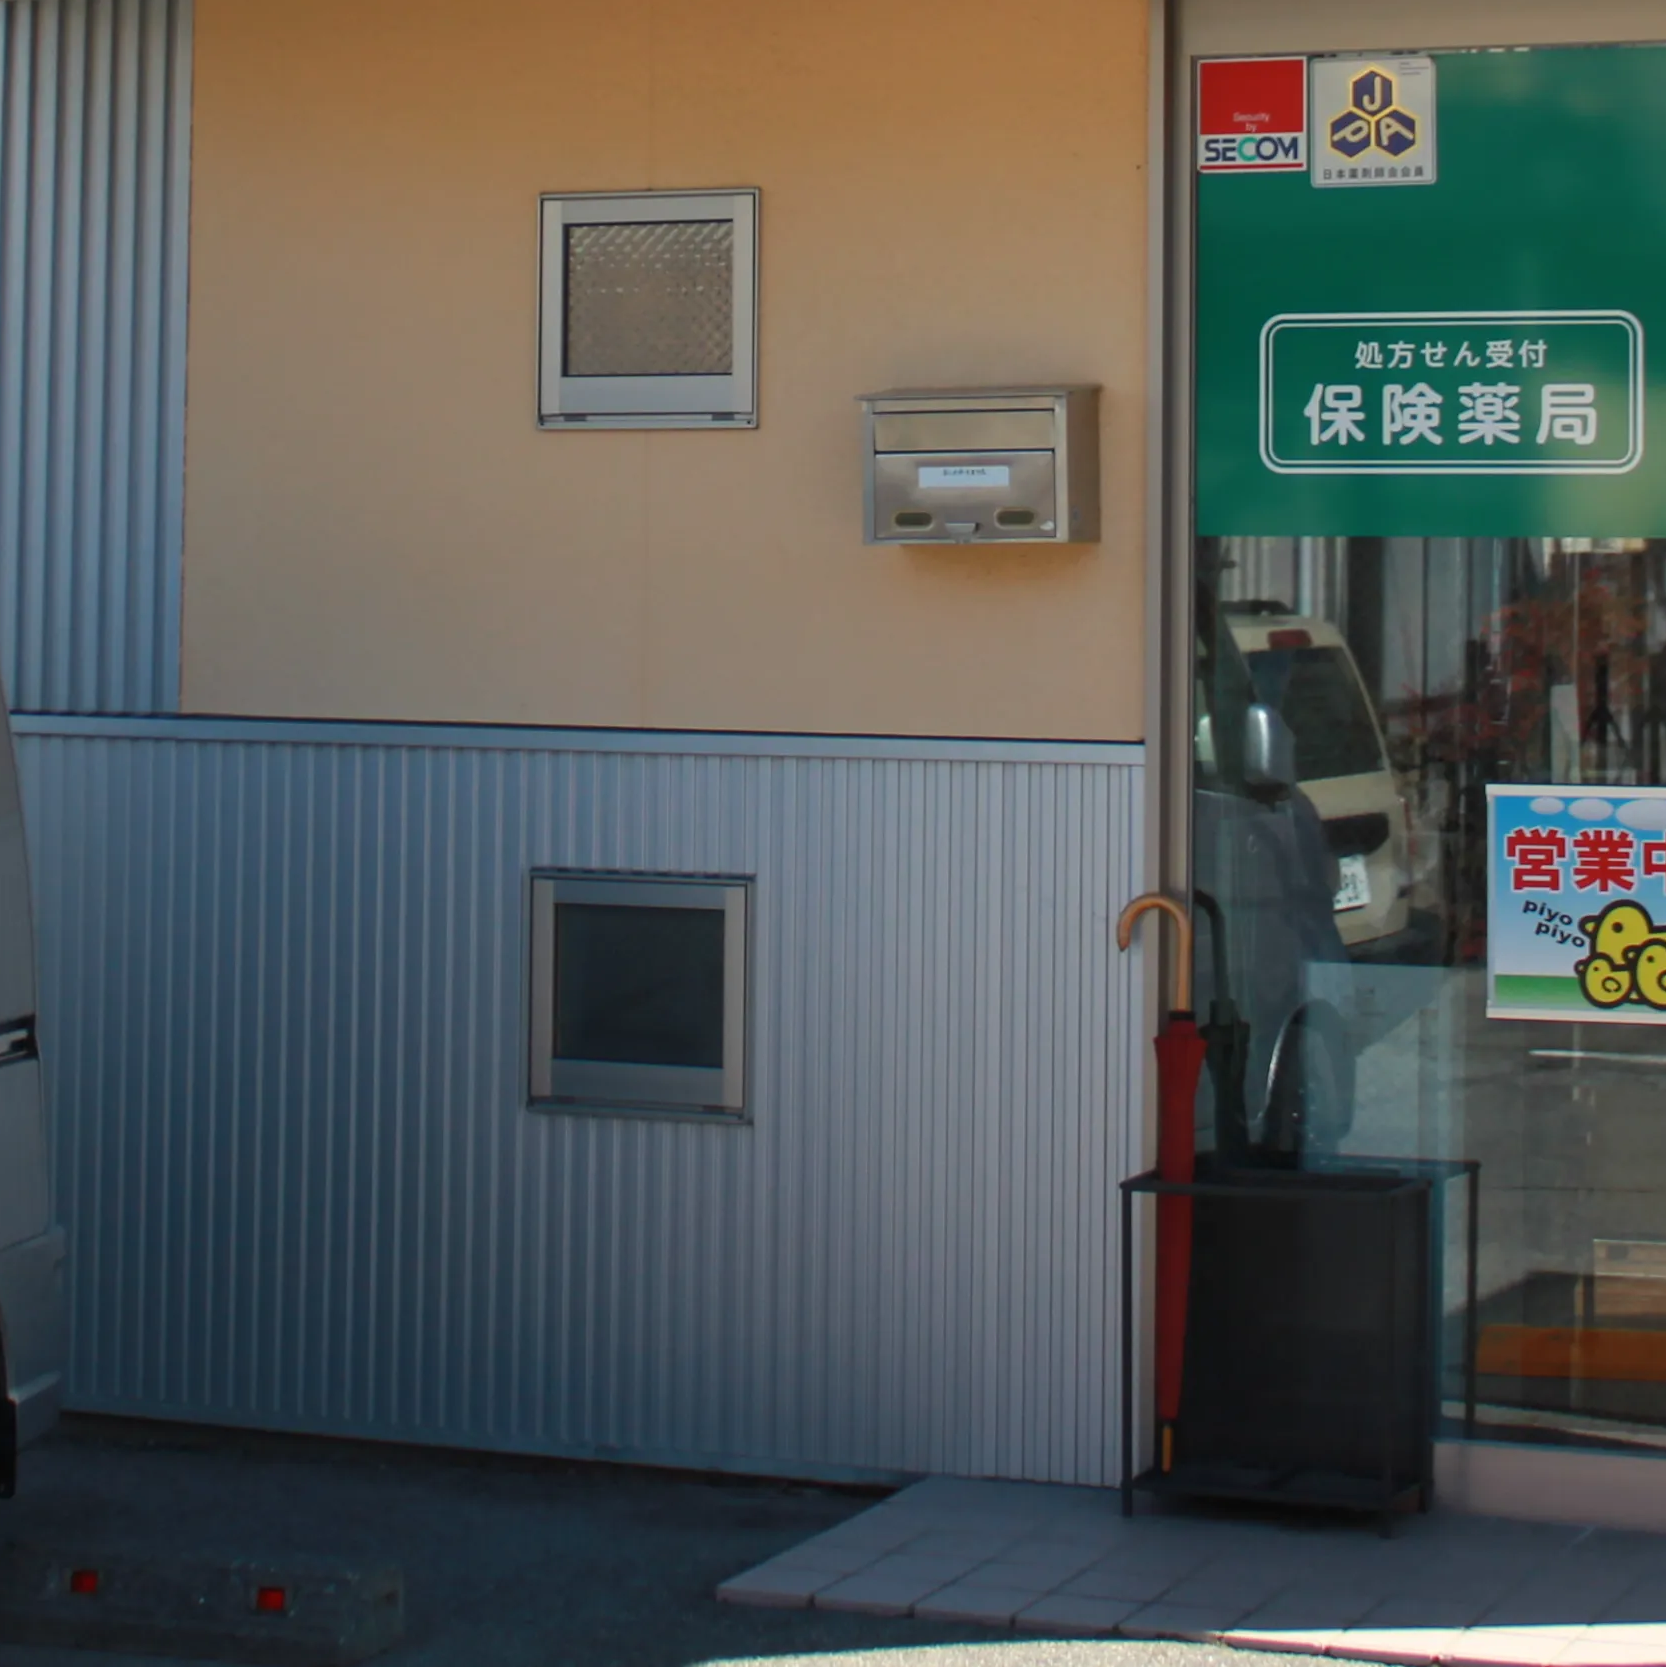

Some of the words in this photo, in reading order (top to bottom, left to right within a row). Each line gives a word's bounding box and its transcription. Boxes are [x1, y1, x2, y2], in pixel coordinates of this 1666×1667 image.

[1204, 136, 1299, 162] SECOM
[1354, 339, 1548, 370] 処方せん受付
[1303, 382, 1598, 446] 保険薬局
[1522, 899, 1573, 927] piyo
[1535, 921, 1585, 948] piyo
